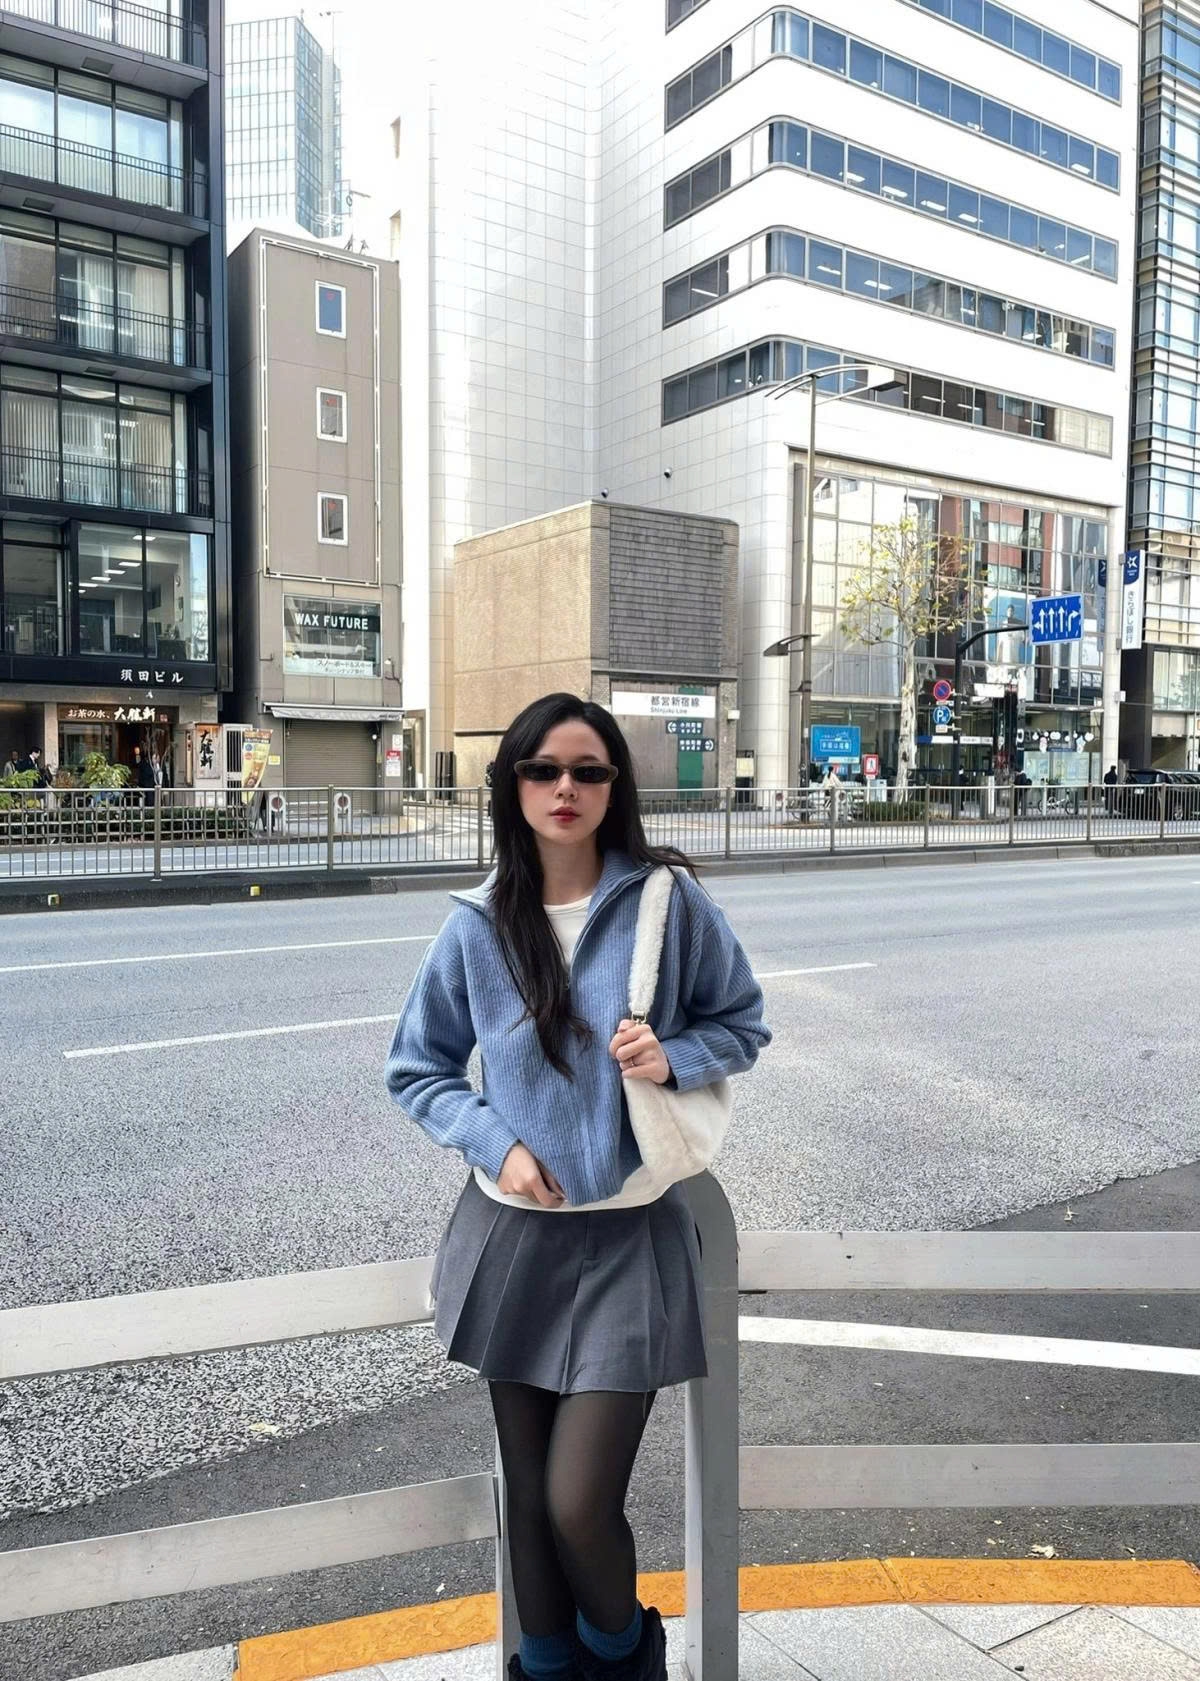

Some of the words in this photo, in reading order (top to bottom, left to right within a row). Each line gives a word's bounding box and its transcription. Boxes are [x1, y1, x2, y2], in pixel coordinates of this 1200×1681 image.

[295, 612, 319, 626] WAX
[324, 615, 369, 630] FUTURE
[120, 668, 184, 684] 須田ビル
[651, 695, 700, 708] 都営新宿線
[650, 706, 674, 714] Shinjuku
[936, 709, 944, 723] P
